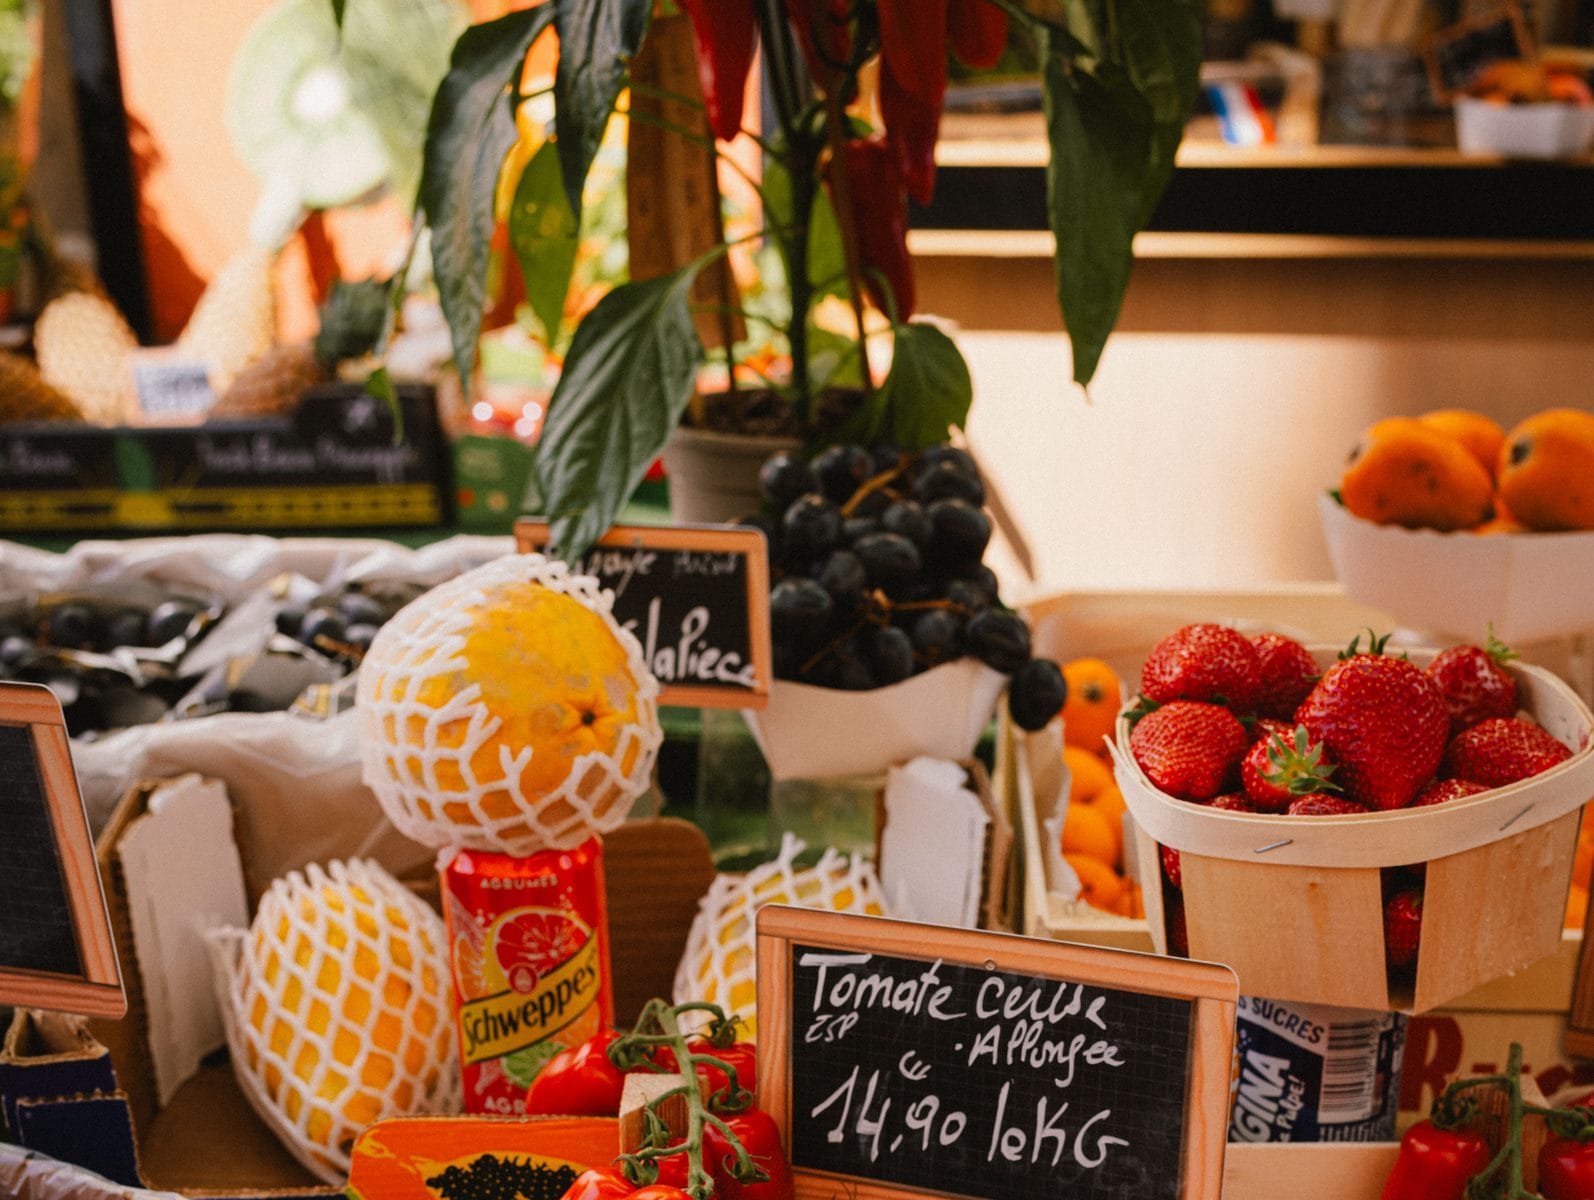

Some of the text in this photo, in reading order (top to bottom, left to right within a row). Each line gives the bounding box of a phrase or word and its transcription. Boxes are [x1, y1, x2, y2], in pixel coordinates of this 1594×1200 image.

[464, 951, 597, 1057] Schweppes
[800, 953, 967, 1020] Tomate
[1252, 997, 1324, 1044] SUCRES
